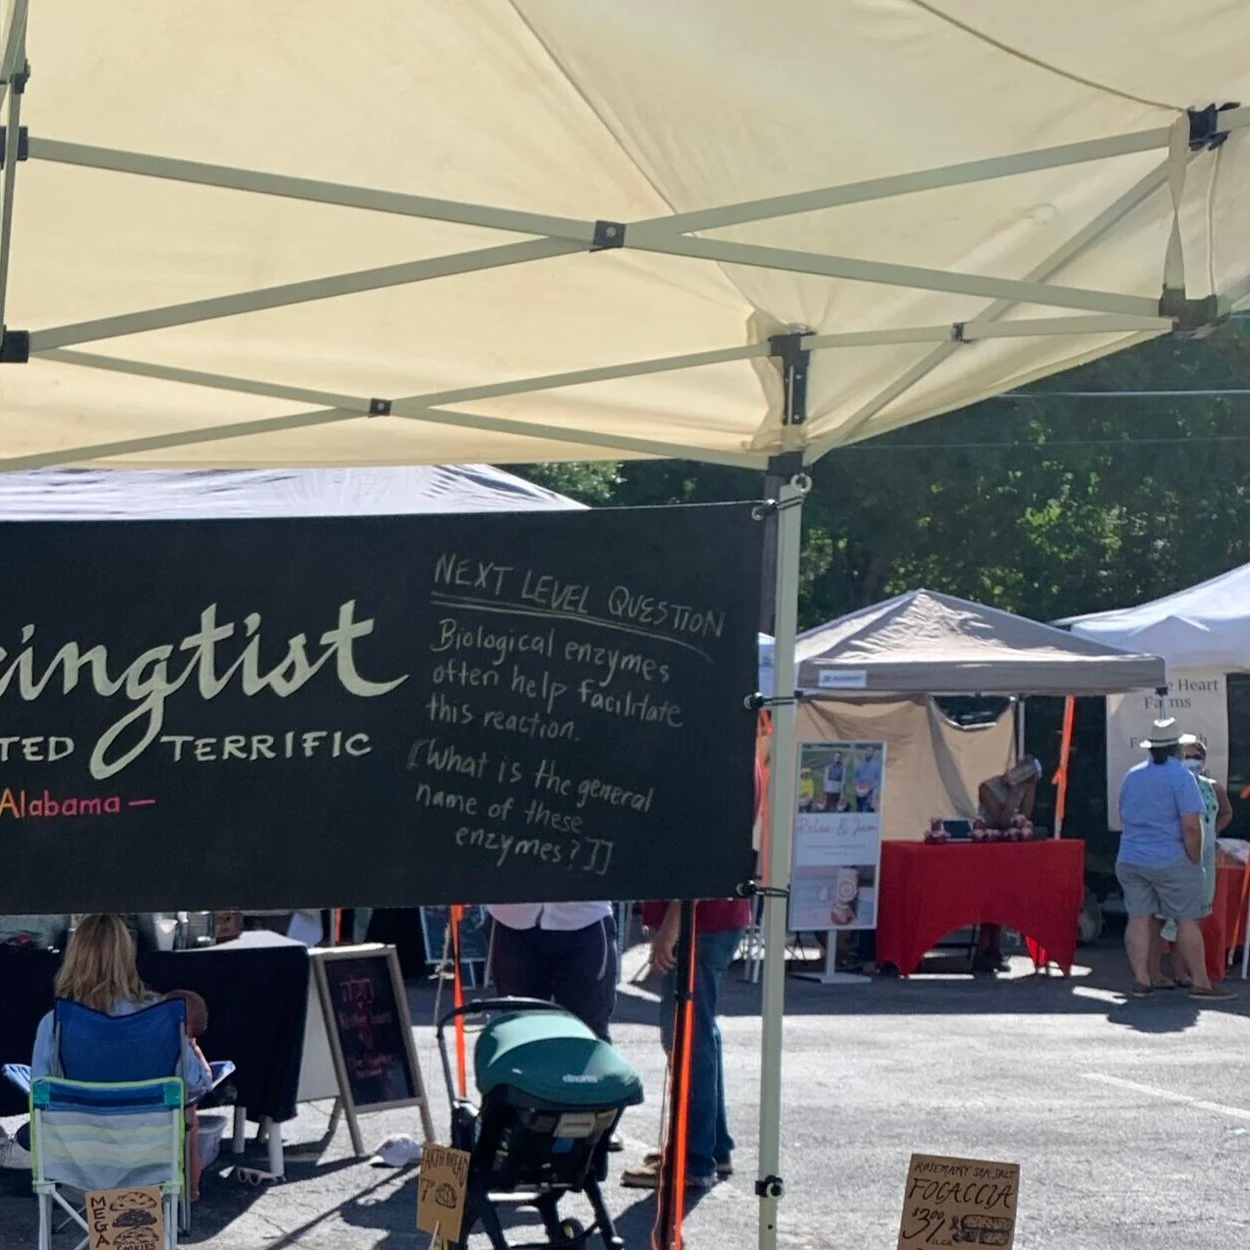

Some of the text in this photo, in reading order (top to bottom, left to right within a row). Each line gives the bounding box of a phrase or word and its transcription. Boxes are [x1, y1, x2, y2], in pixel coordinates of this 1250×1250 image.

[434, 552, 726, 638] NEXT LEVEL QUESTION
[430, 618, 671, 687] Biological enzymes
[432, 658, 683, 727] often help facilitate
[1144, 697, 1191, 709] Fams
[1178, 679, 1218, 691] Heart
[426, 695, 580, 742] this reaction.
[160, 730, 373, 762] TERRIFIC
[415, 783, 583, 834] name of these
[499, 755, 522, 783] is
[535, 759, 571, 797] the
[577, 779, 655, 813] general
[908, 1178, 1014, 1209] FOCACCIA
[91, 1196, 110, 1248] MEGA
